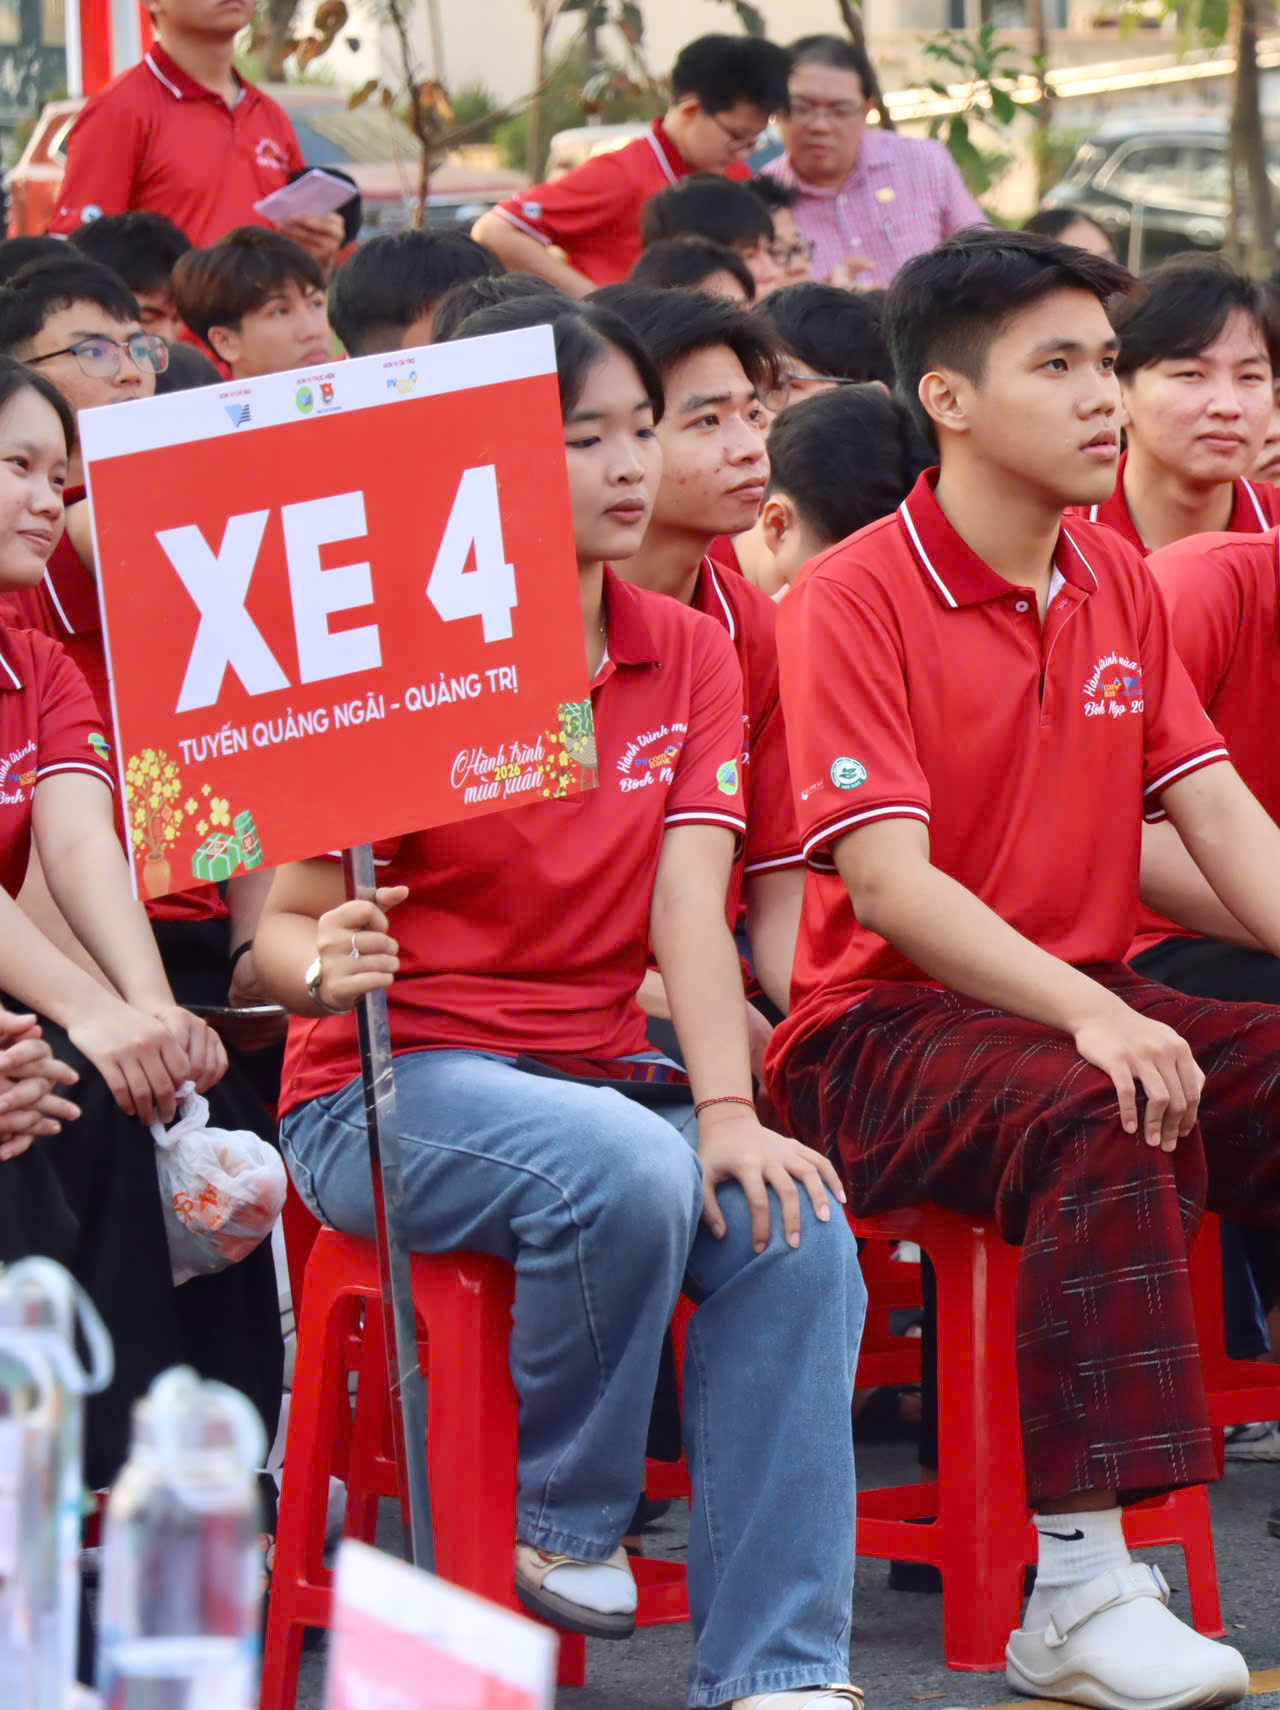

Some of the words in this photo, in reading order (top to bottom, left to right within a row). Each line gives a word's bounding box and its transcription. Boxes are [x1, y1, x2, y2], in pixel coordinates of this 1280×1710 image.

[155, 490, 383, 713] XE
[425, 464, 518, 643] 4
[178, 721, 249, 765] TUYẾN
[252, 708, 329, 747] QUẢNG
[333, 692, 386, 729] NGÃI
[405, 672, 482, 711] QUẢNG
[485, 665, 518, 693] TRỊ
[451, 744, 506, 789] Hành
[509, 736, 545, 765] trình
[464, 776, 500, 805] mùa
[503, 766, 544, 800] xuân
[494, 763, 521, 781] 2026
